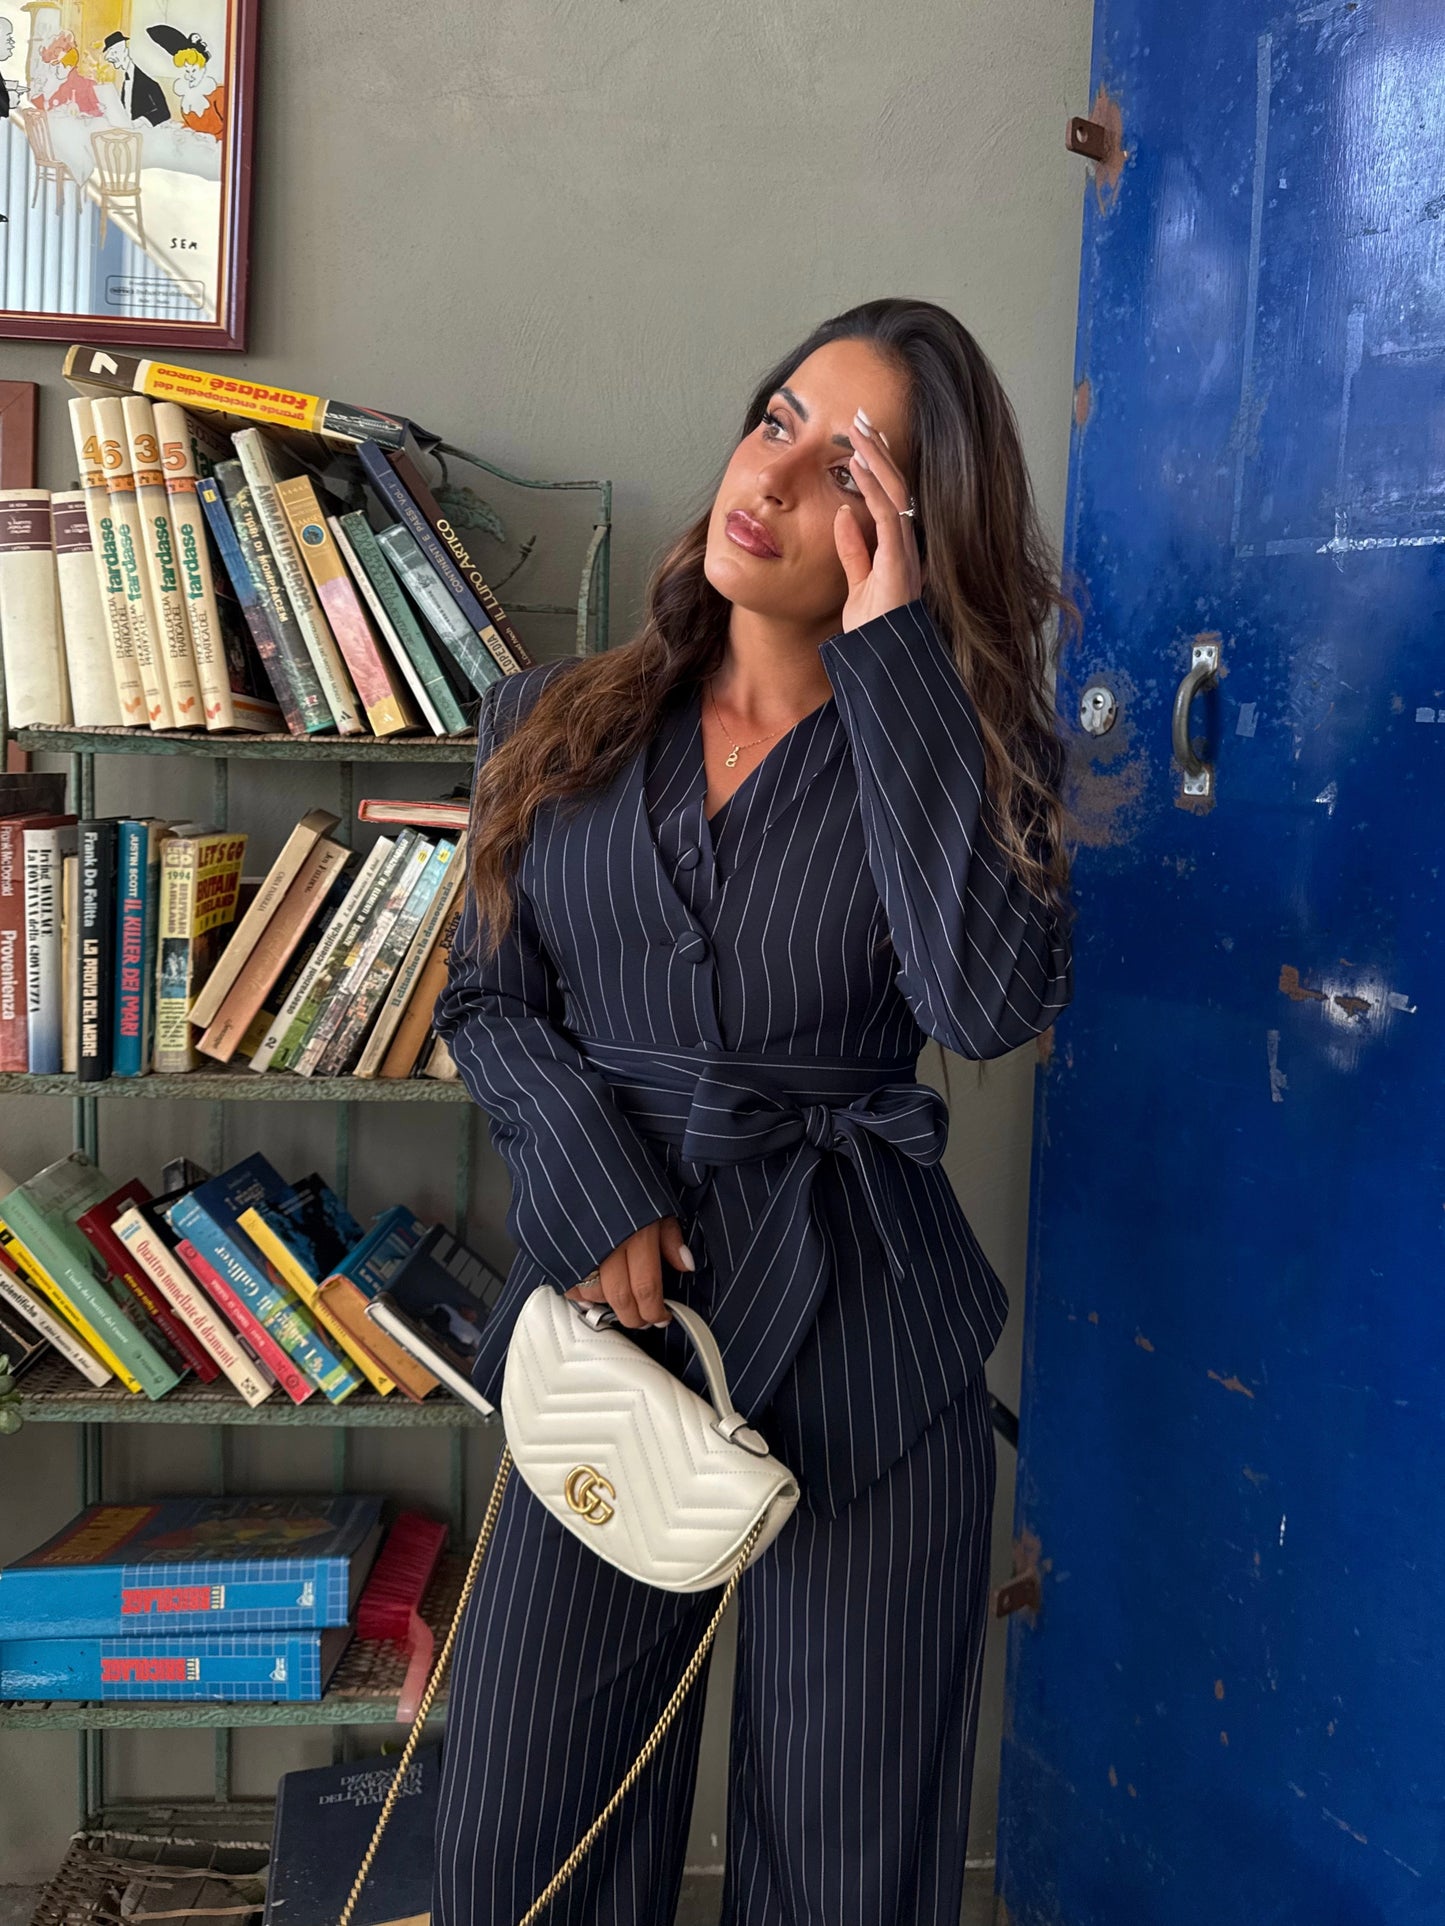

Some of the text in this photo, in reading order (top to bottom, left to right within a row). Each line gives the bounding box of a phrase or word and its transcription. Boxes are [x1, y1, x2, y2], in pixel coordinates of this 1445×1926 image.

[89, 351, 118, 375] 7
[101, 440, 122, 469] 6
[134, 434, 159, 463] 3
[162, 442, 187, 471] 5
[243, 510, 260, 539] TIGRI
[253, 539, 265, 552] DI
[254, 483, 290, 546] ANIMALI
[403, 505, 425, 533] PAESI
[430, 542, 465, 594] CONTINENTI
[108, 596, 124, 659] ENCICLOPEDIA
[117, 604, 133, 658] PRATICA DEL
[162, 596, 178, 658] ENCICLOPEDIA
[171, 604, 187, 657] PRATICA DEL
[198, 610, 214, 663] PRATICA DEL
[83, 832, 98, 865] Frank
[84, 868, 98, 886] De
[167, 871, 191, 880] 1994
[83, 888, 98, 927] Felitta
[421, 879, 454, 938] democrazia
[28, 919, 40, 942] della
[120, 833, 143, 1036] JUSTIN SCOTT IL KILLER DEI MARI
[417, 935, 429, 949] la
[1, 930, 17, 1020] Provenienza
[265, 1037, 278, 1049] 2
[286, 967, 316, 1016] osservazioni
[314, 922, 344, 967] scientifiche
[394, 952, 421, 999] cittadino
[134, 1238, 168, 1279] Quattro
[214, 1245, 260, 1297] Gulliver
[159, 1272, 199, 1320] tonnellate
[256, 1295, 274, 1311] di
[191, 1313, 209, 1330] di
[199, 1323, 240, 1369] diamanti
[121, 1585, 211, 1614] BRICOLAGE
[101, 1658, 186, 1682] BRICOLAGE
